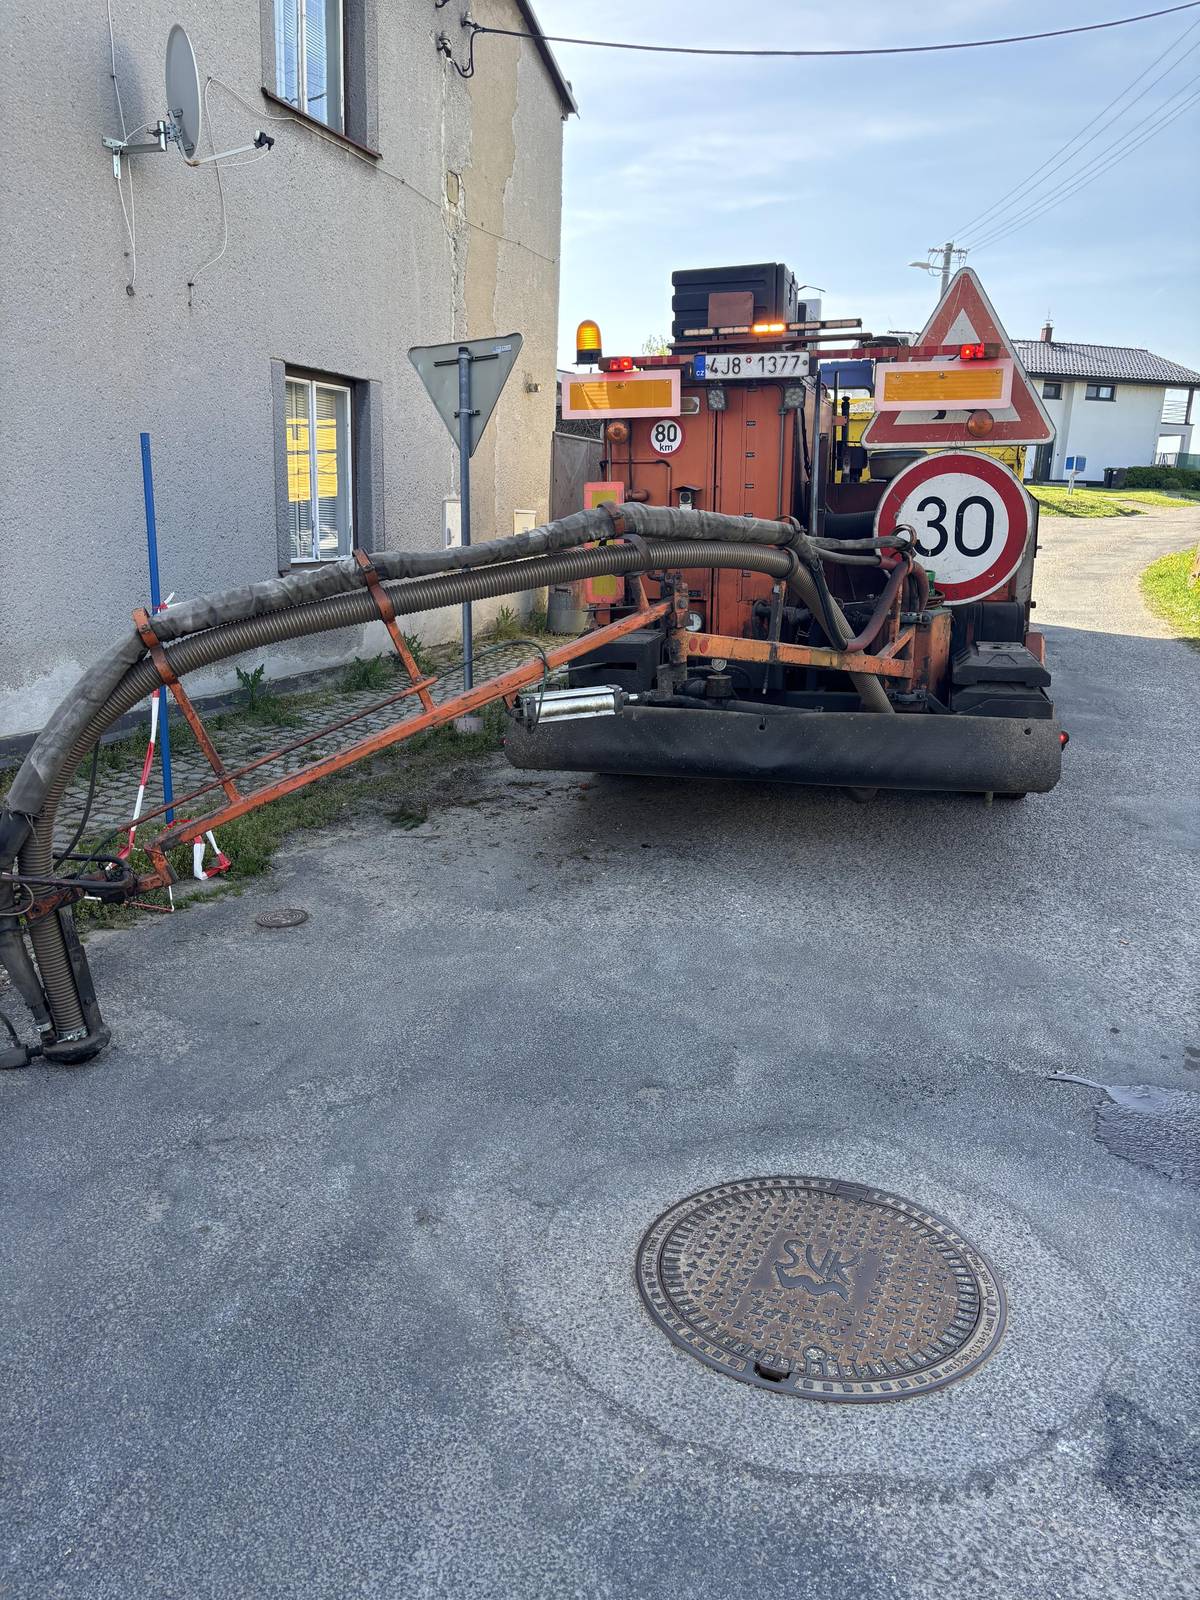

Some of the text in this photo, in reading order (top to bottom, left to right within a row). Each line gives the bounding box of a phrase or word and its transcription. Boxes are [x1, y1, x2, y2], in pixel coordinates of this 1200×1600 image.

[709, 354, 801, 375] 4J8 1377
[654, 423, 678, 443] 80
[659, 443, 673, 452] km
[912, 495, 995, 558] 30
[774, 1239, 861, 1286] SVK
